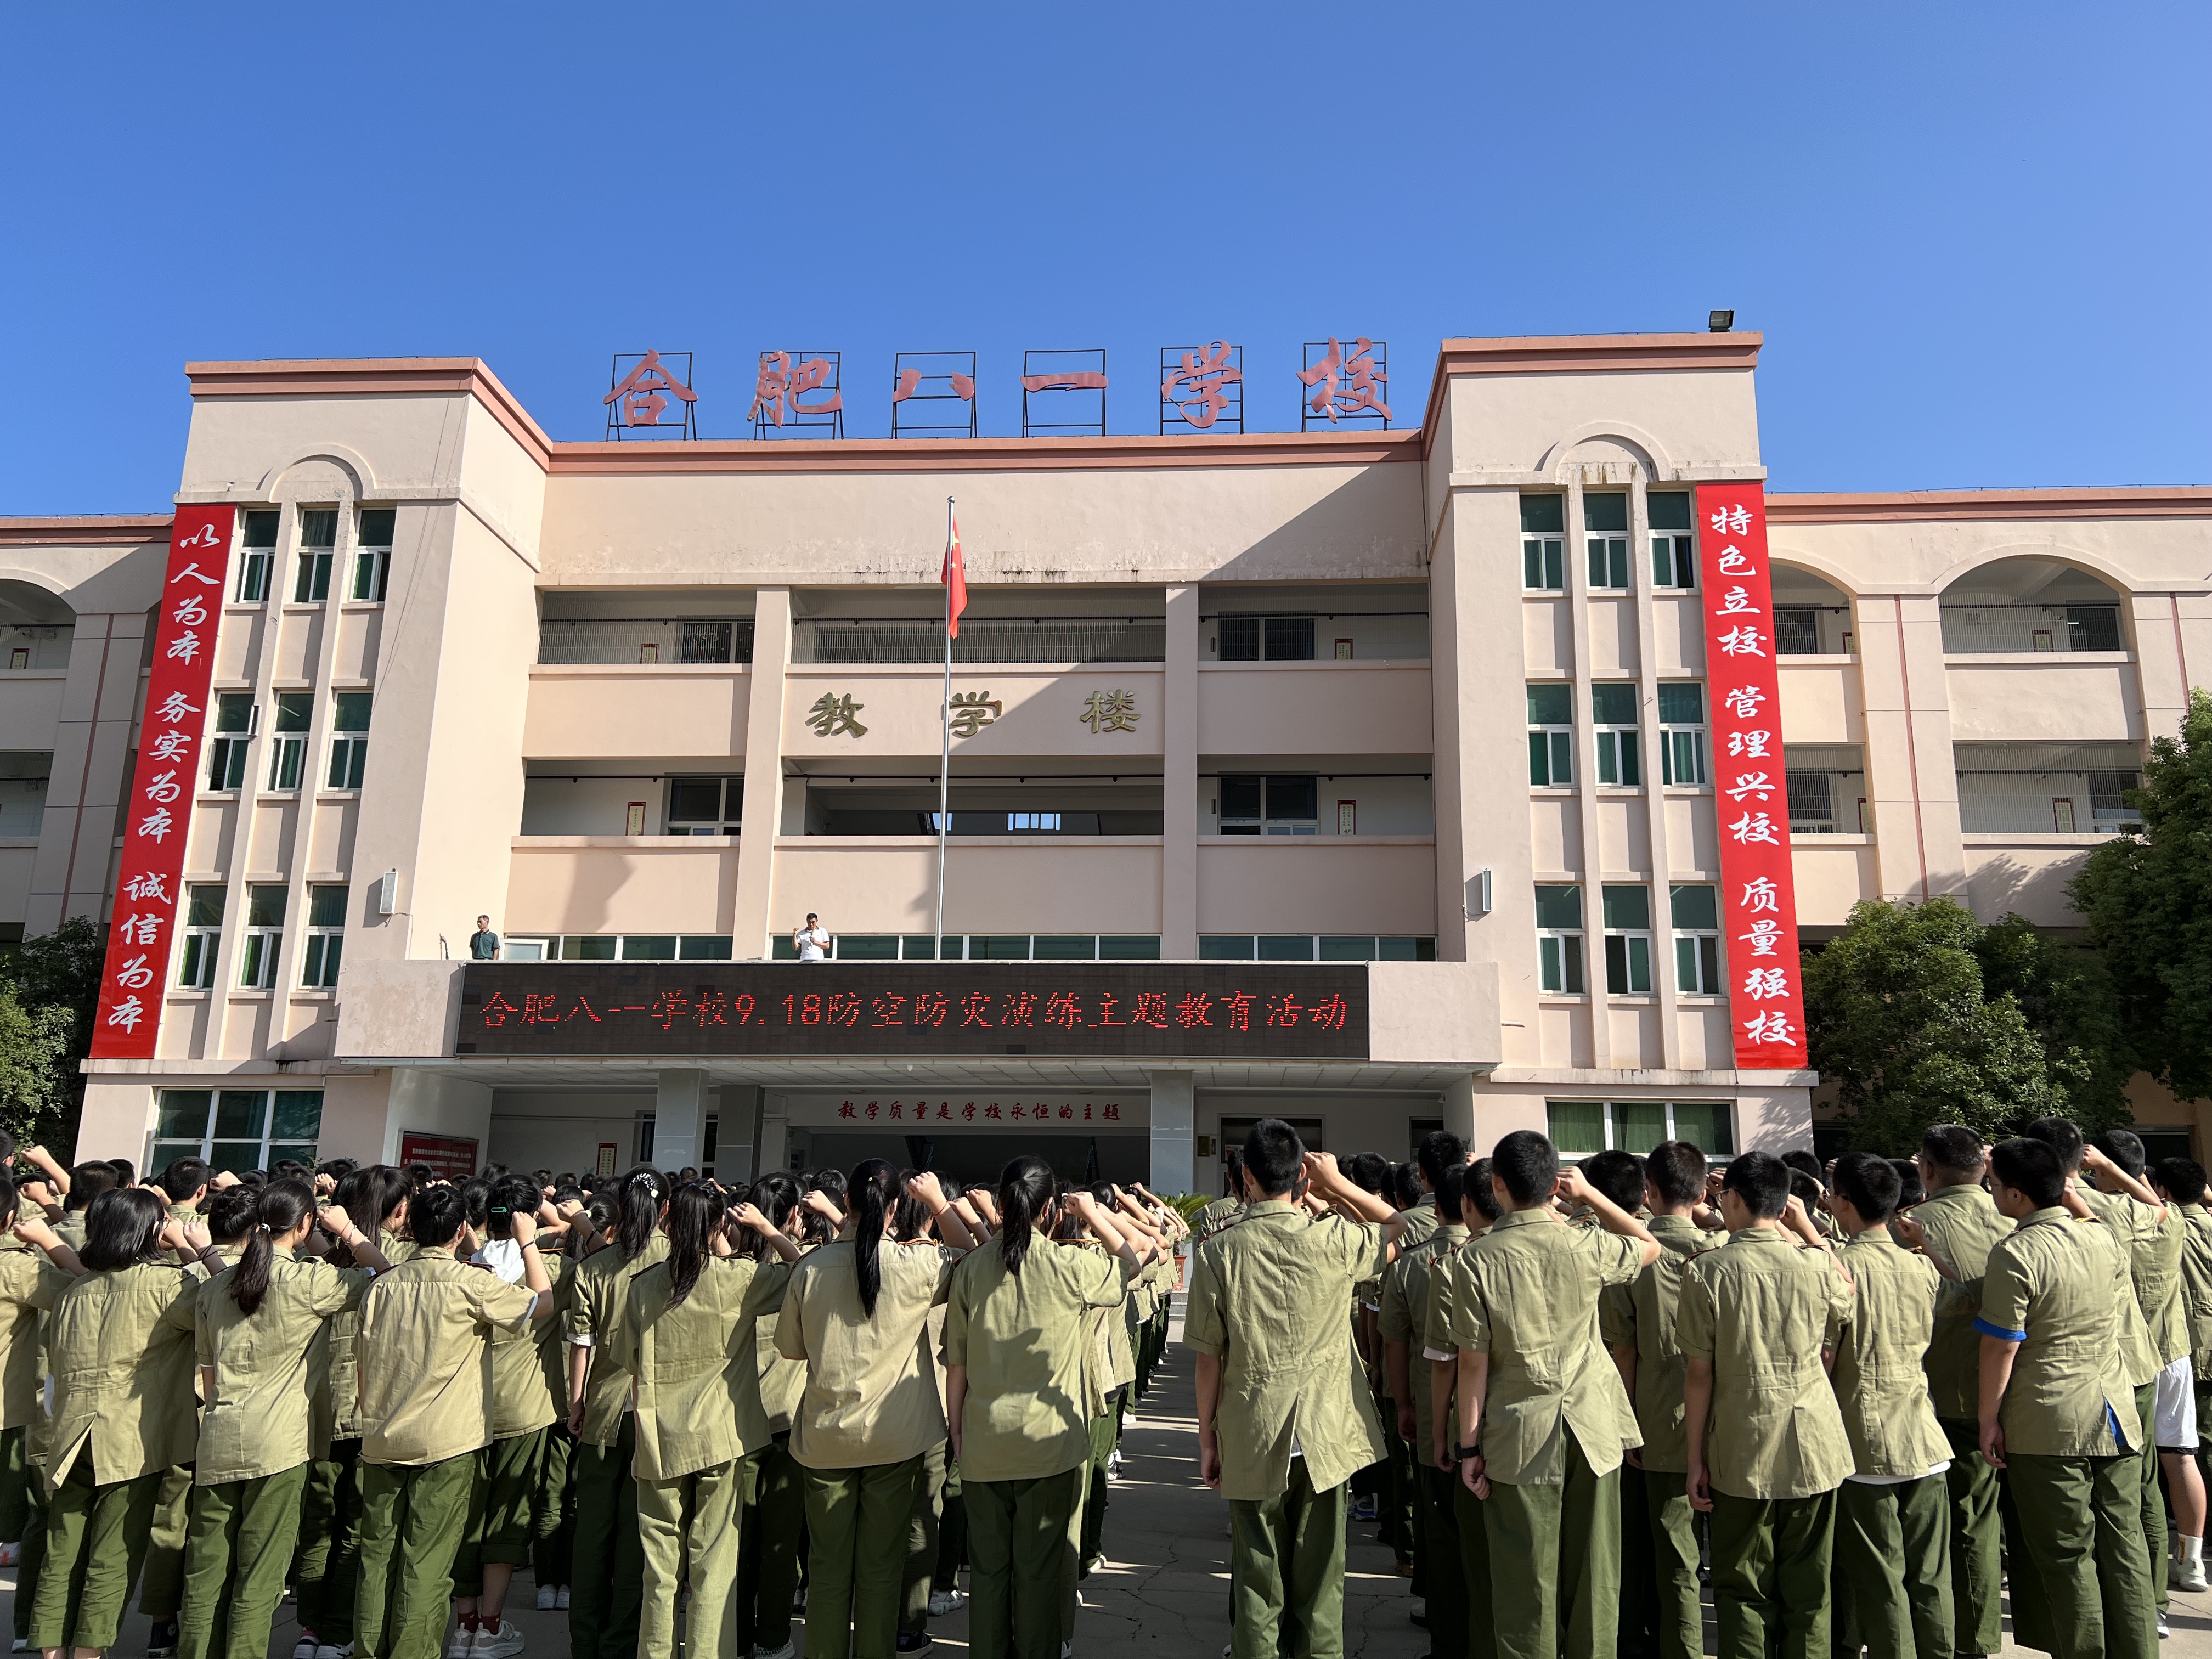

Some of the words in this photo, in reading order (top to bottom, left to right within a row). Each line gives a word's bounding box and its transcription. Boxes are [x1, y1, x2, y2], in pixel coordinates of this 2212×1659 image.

[604, 337, 1392, 428] 合肥八一学校
[167, 523, 221, 665] 以人为本
[1711, 504, 1767, 658] 特色立校
[138, 690, 201, 844] 务实为本
[808, 689, 1141, 737] 教学楼
[1725, 685, 1780, 846] 管理兴校
[108, 871, 172, 1034] 诚信为本
[1738, 876, 1797, 1047] 质量强校
[837, 1100, 1121, 1121] 教学质量是学校永恒的主题
